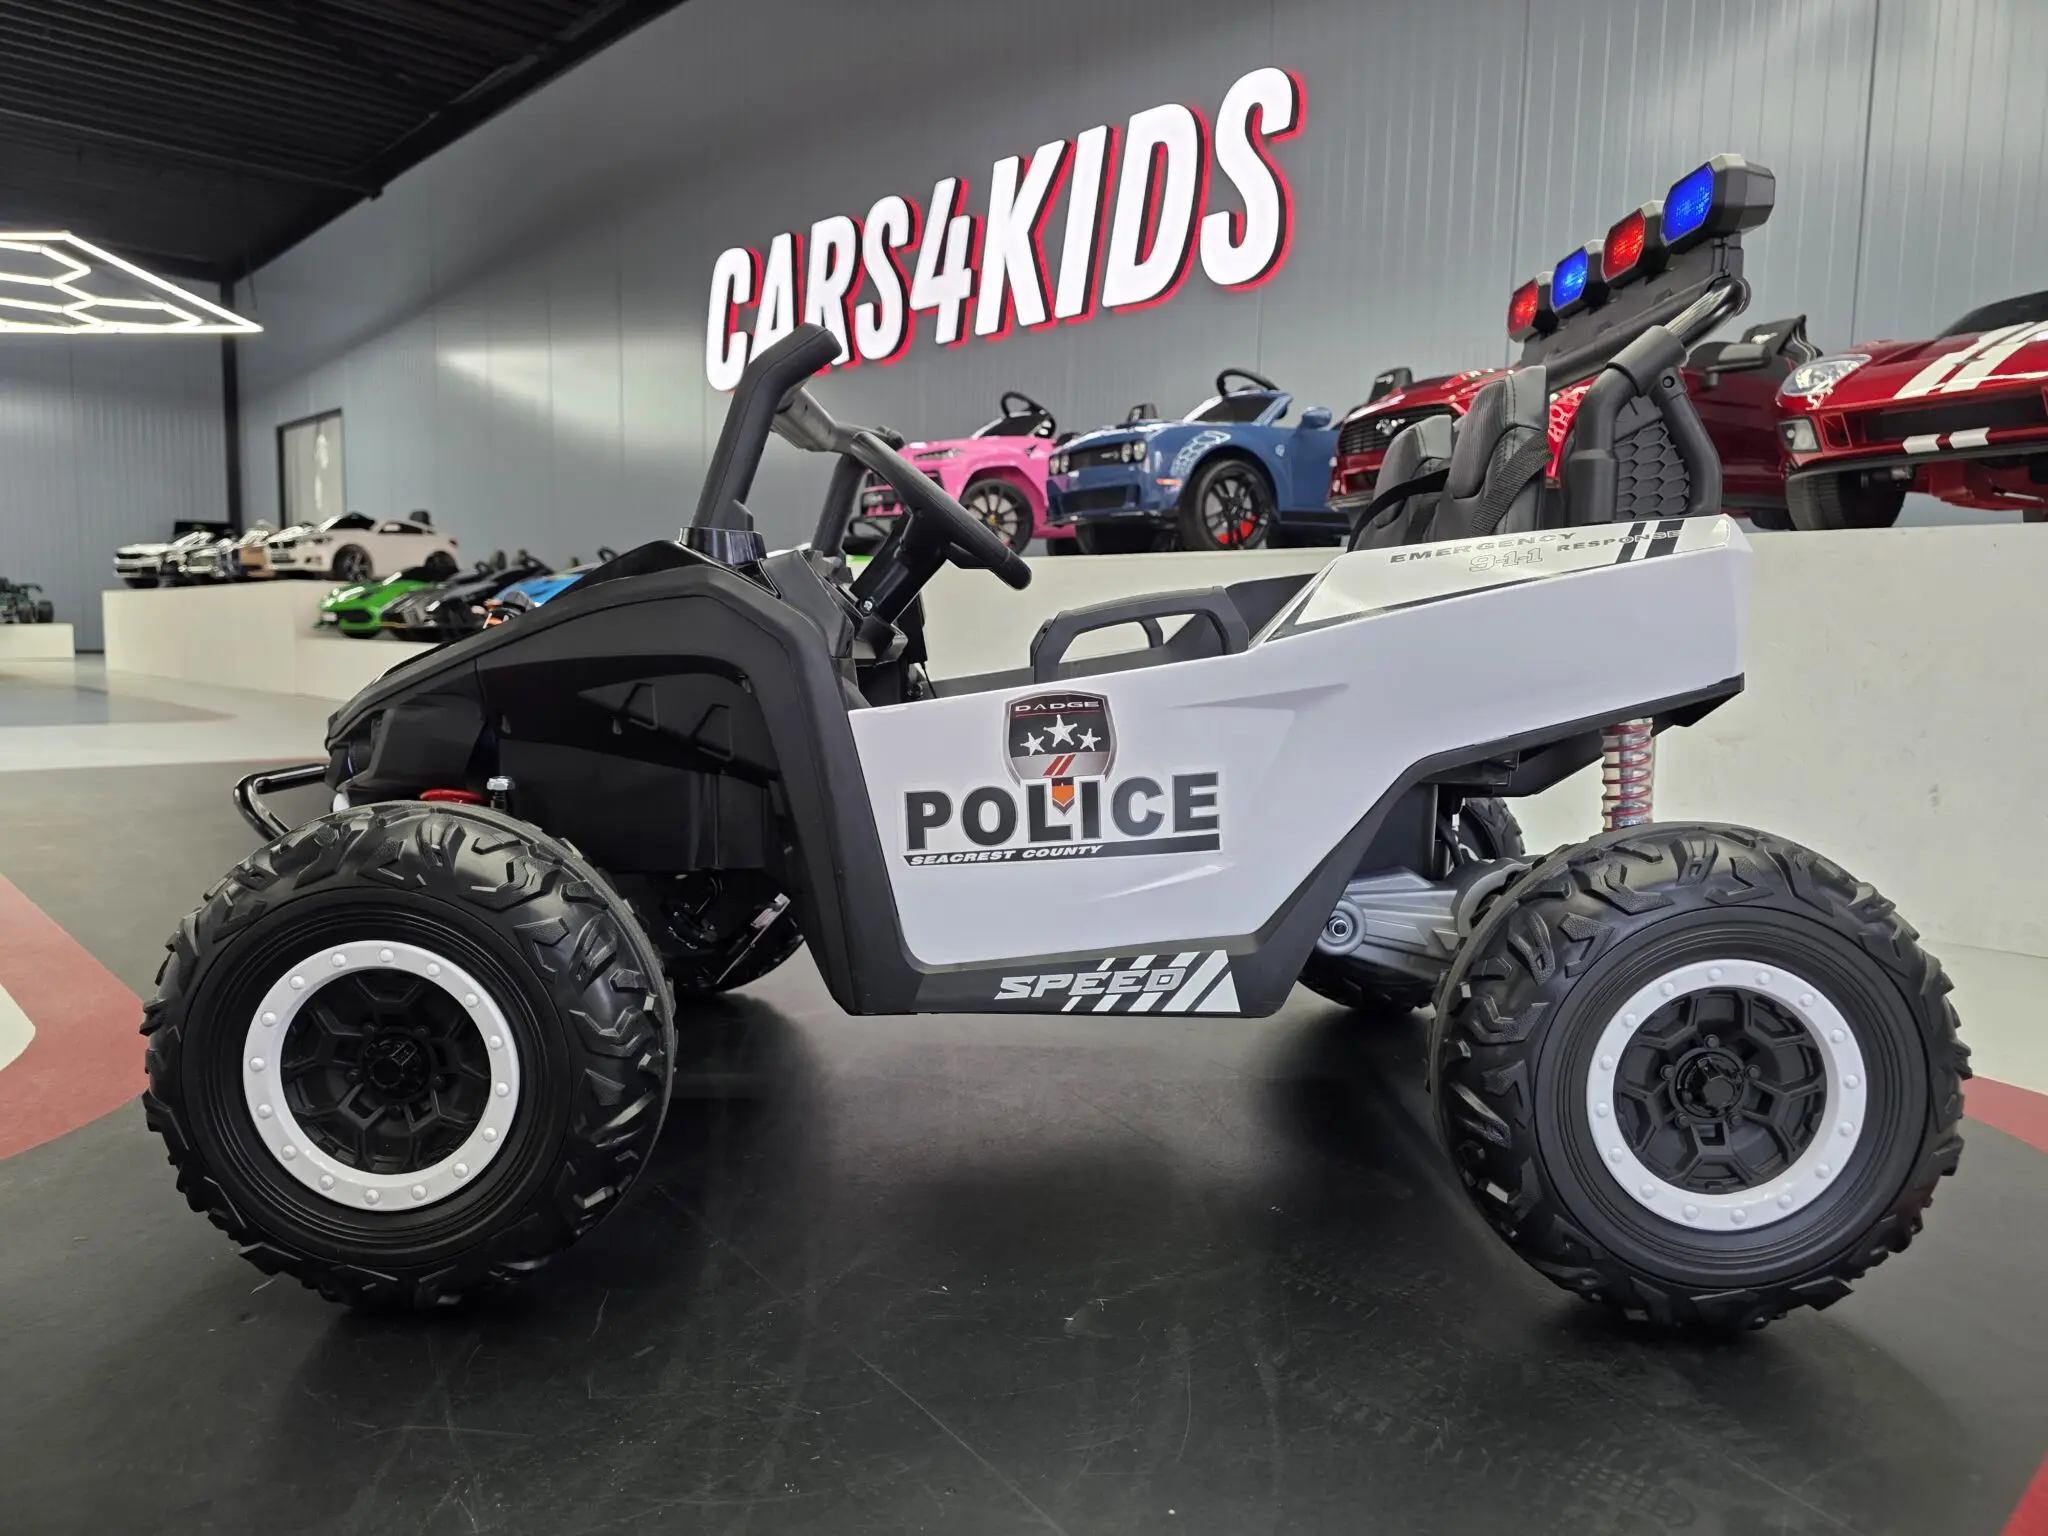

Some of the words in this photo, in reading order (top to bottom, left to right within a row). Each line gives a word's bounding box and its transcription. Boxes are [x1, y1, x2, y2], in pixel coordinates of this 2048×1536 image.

[705, 66, 1301, 393] CARS4KIDS
[1389, 531, 1577, 564] EMERGENCY
[1556, 529, 1681, 552] RESPONSE
[903, 771, 1221, 851] POLICE
[910, 849, 1016, 866] SEACREST
[1022, 844, 1105, 859] COUNTY
[994, 967, 1187, 1001] SPEED
